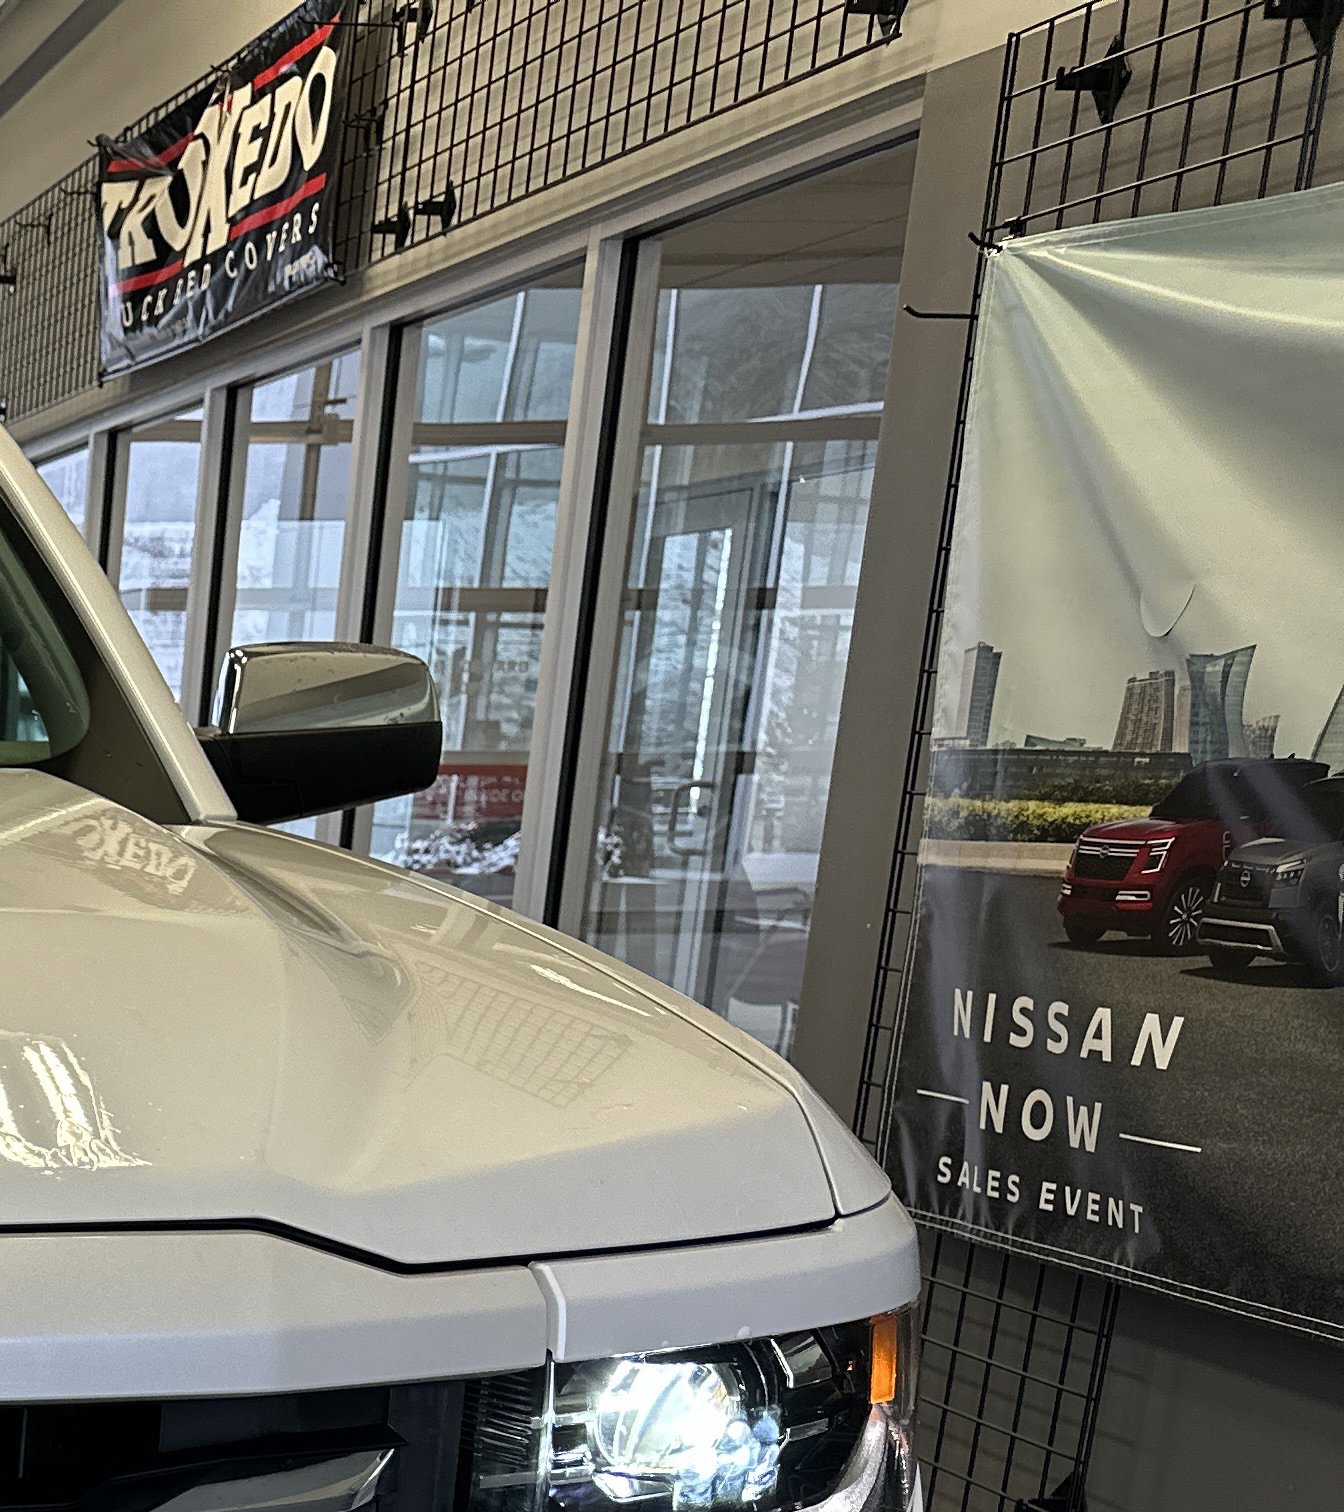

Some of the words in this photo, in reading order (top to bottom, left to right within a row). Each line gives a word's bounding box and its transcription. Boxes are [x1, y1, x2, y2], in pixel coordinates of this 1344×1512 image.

[101, 45, 337, 269] TRUXEDO
[121, 288, 168, 327] UCK
[225, 202, 320, 278] COVERS
[952, 987, 1185, 1070] NISSAN
[978, 1080, 1102, 1153] NOW
[937, 1155, 1021, 1204] SALES
[1039, 1181, 1144, 1234] EVENT
